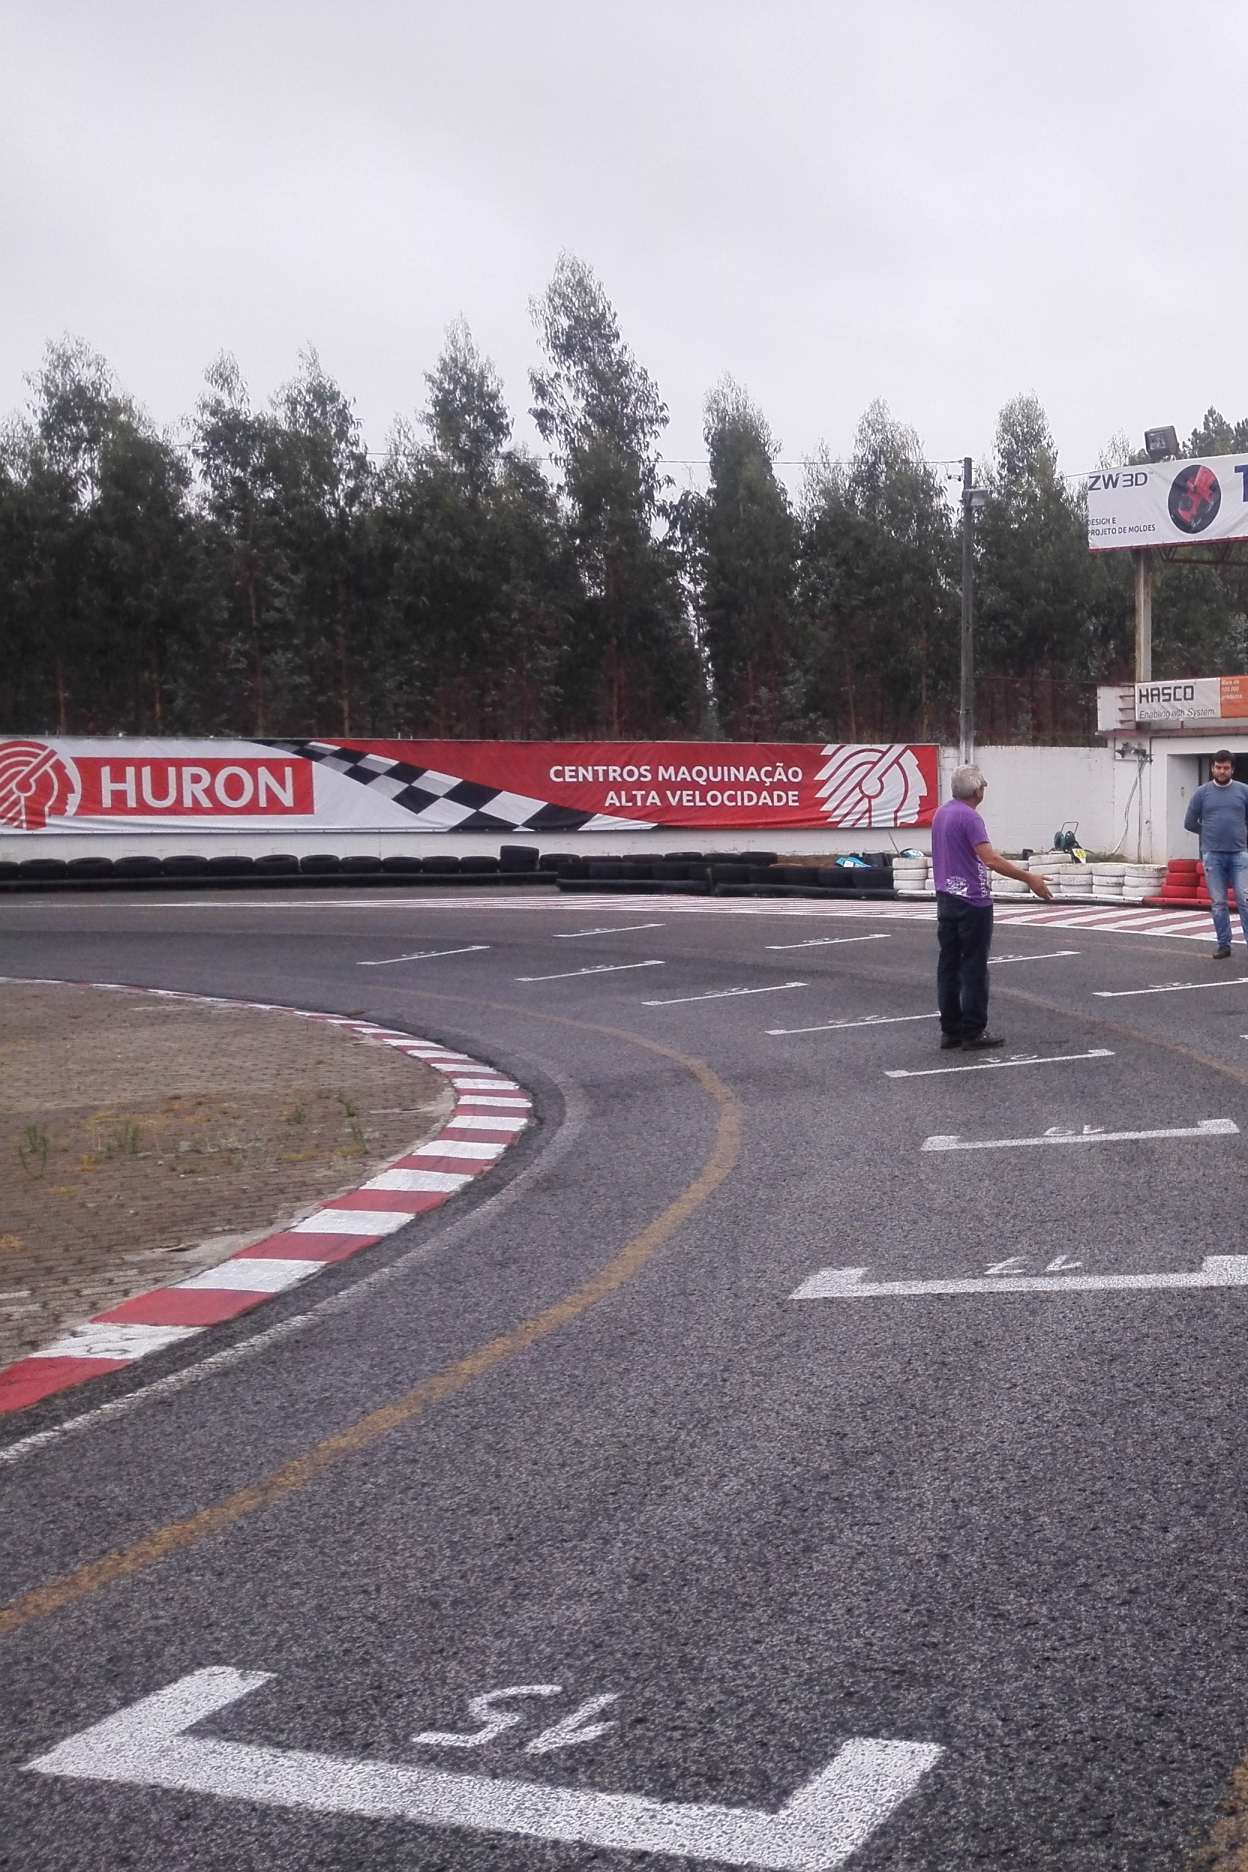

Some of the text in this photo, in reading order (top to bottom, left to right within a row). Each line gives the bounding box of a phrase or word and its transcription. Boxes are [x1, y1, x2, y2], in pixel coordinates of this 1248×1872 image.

[1088, 472, 1148, 491] ZW3D
[1128, 524, 1156, 533] MOLDES
[1139, 685, 1194, 704] HASCO
[549, 761, 803, 787] CENTROS MAQUINAÇÃO
[101, 765, 294, 808] HURON
[604, 790, 799, 807] ALTA VELOCIDADE
[983, 1254, 1083, 1276] 17
[409, 1683, 622, 1756] 15
